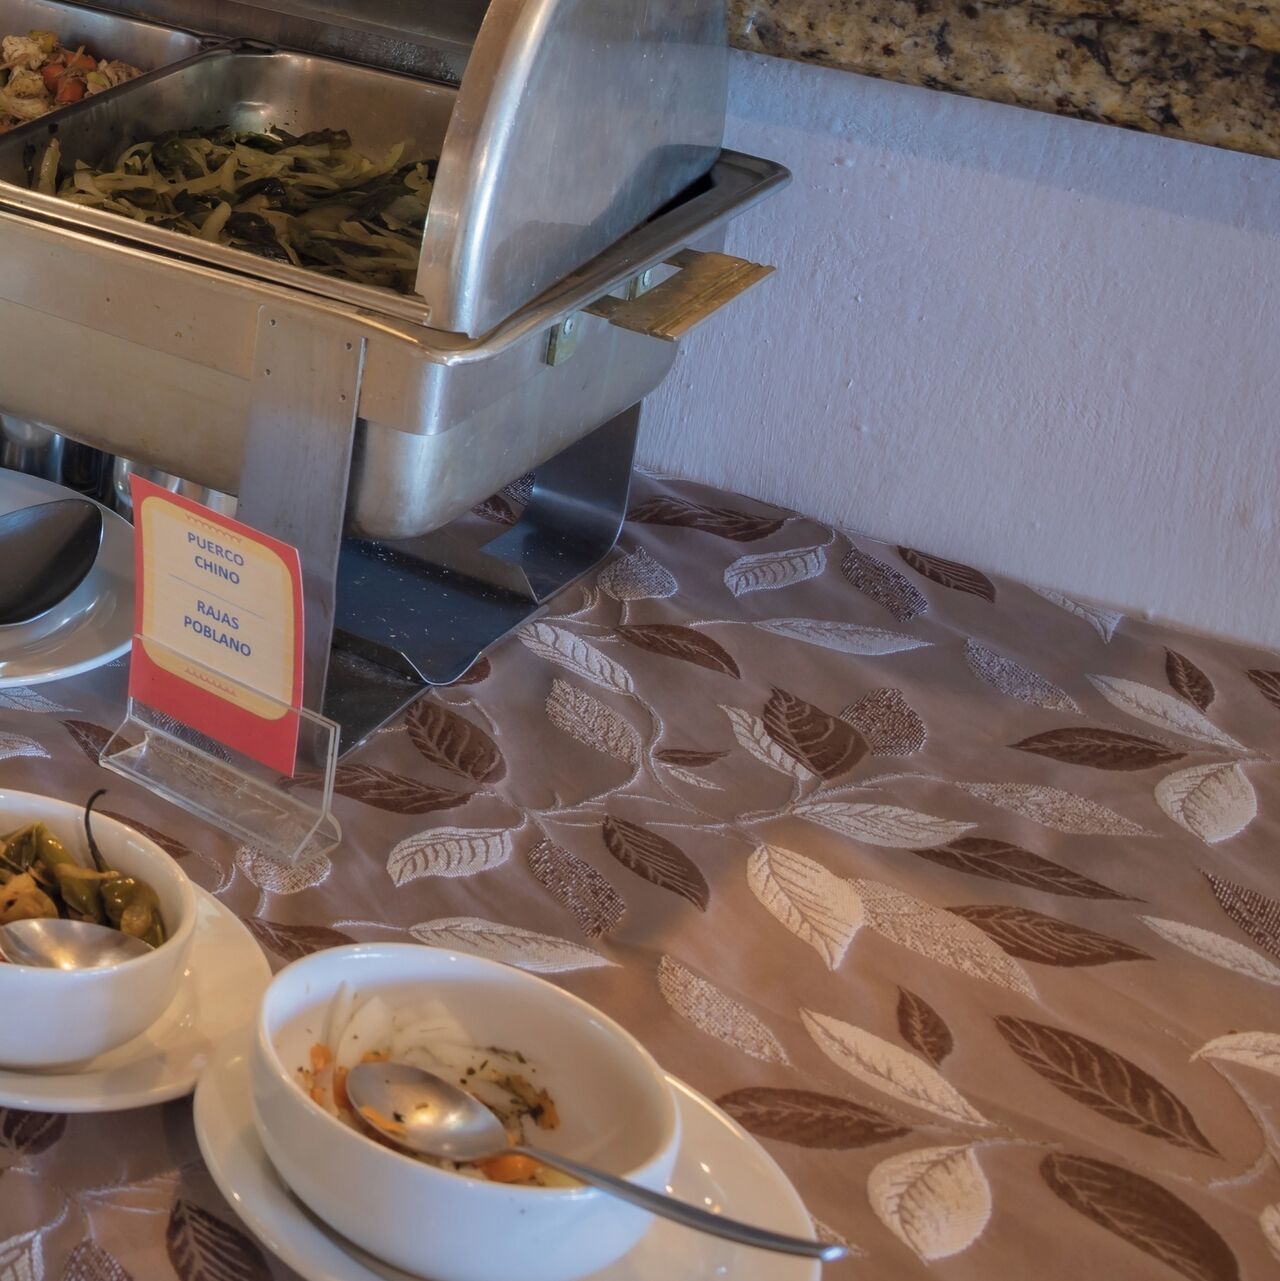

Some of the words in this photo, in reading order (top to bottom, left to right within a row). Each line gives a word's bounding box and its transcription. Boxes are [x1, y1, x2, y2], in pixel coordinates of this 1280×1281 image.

[186, 531, 245, 567] PUERCO
[194, 555, 241, 586] CHINO
[196, 599, 240, 631] RAJAS
[183, 615, 252, 658] POBLANO
